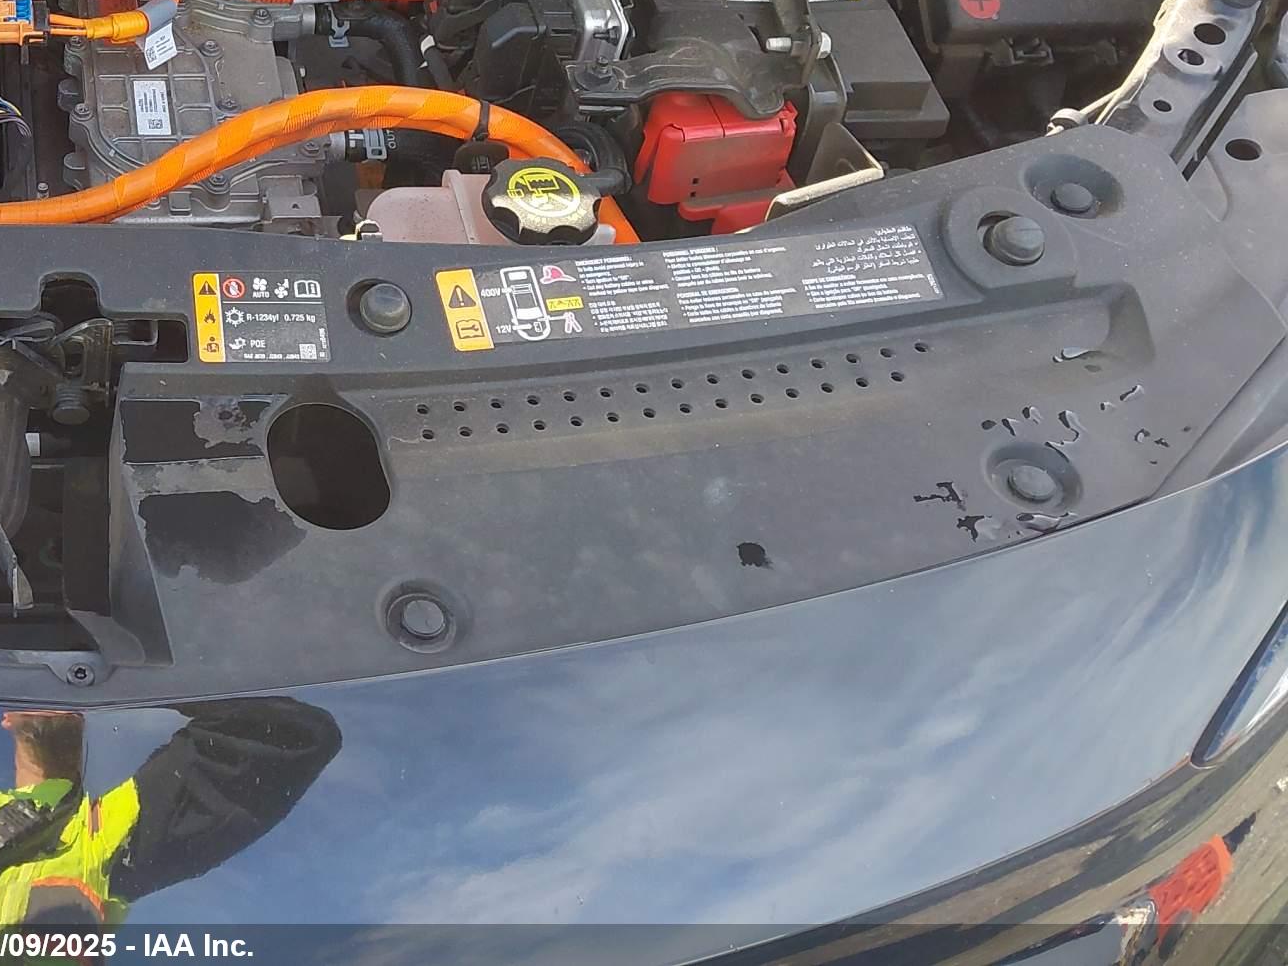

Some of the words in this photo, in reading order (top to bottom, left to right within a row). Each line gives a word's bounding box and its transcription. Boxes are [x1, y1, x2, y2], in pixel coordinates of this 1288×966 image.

[481, 288, 501, 298] 400V
[284, 314, 304, 322] 0.725
[305, 314, 316, 323] kg
[495, 325, 512, 333] 12V
[250, 339, 266, 348] POE
